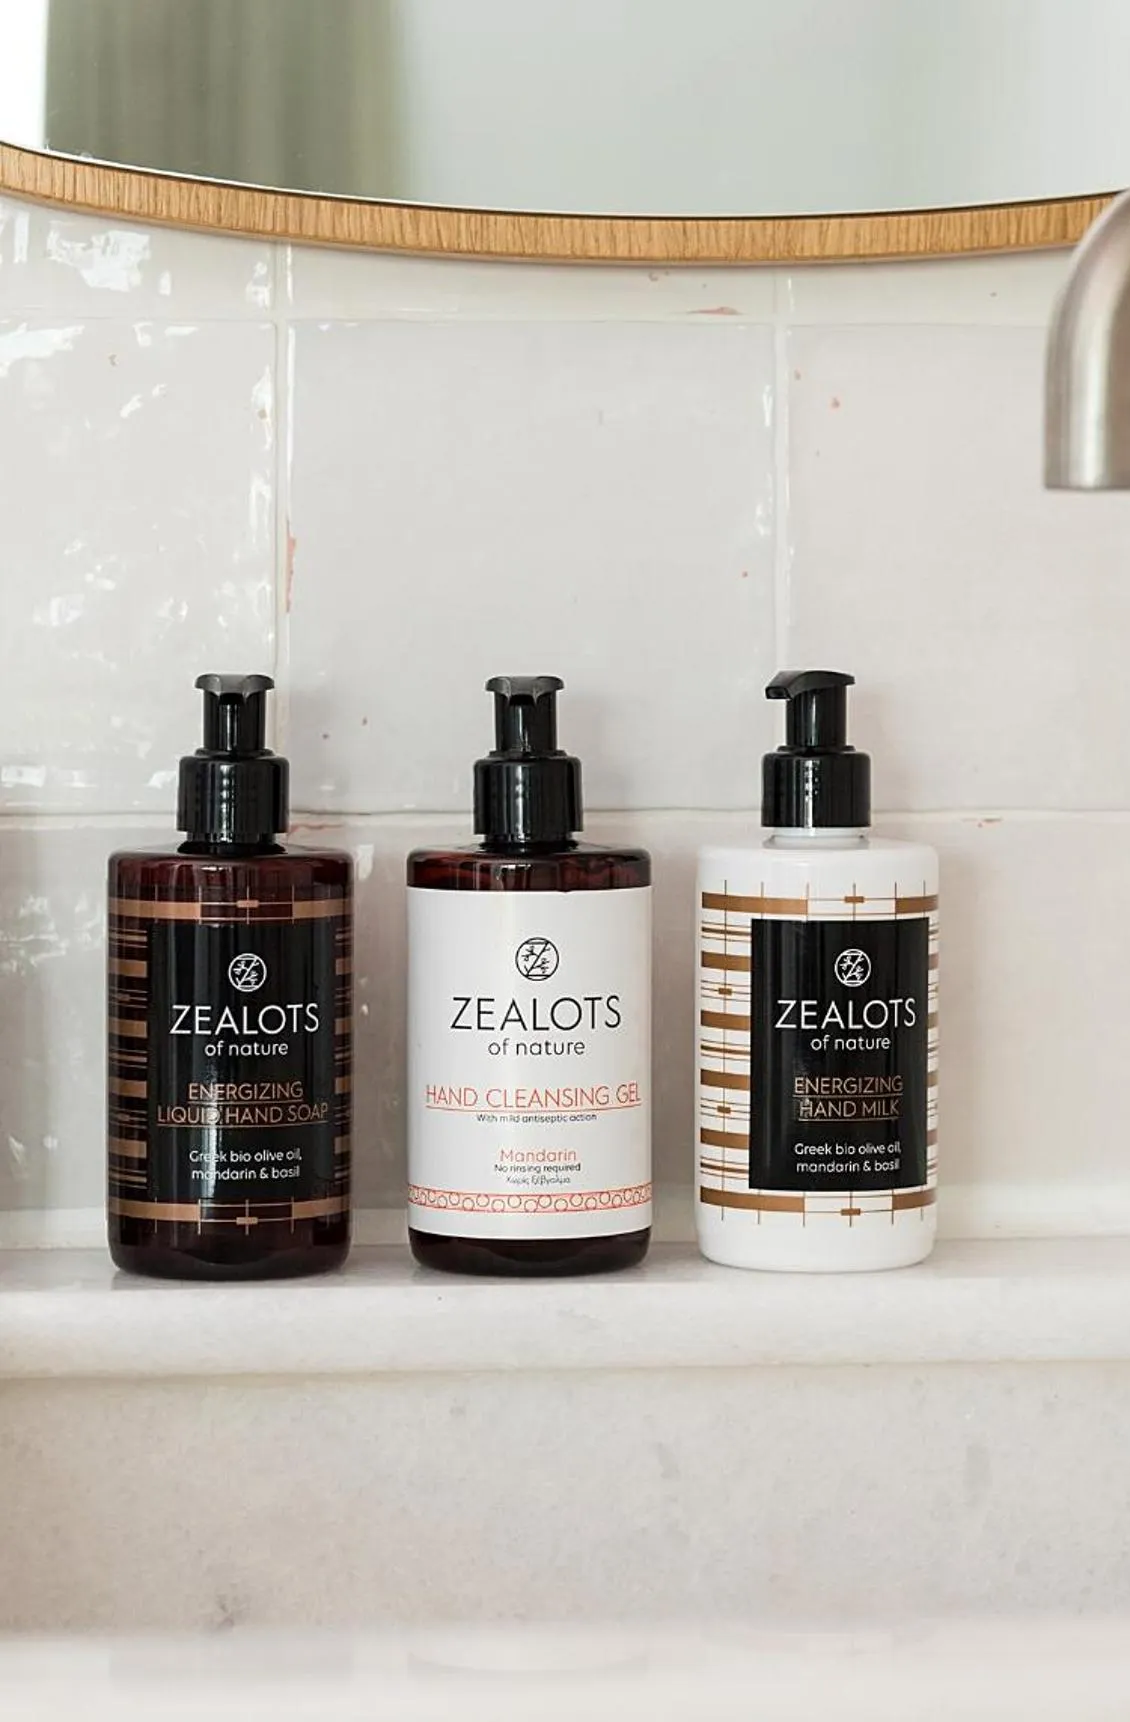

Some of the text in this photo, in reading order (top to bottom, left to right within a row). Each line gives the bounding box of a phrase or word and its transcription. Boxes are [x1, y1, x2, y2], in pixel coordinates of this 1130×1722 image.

[169, 1003, 319, 1035] ZEALOTS
[450, 995, 622, 1031] ZEALOTS
[774, 998, 916, 1030] ZEALOTS
[204, 1040, 289, 1056] of nature
[487, 1038, 586, 1056] of nature
[810, 1034, 891, 1050] of nature
[188, 1081, 304, 1101] ENERGIZING
[794, 1075, 904, 1095] ENERGIZING
[425, 1080, 641, 1109] HAND CLEANSING GEL
[157, 1103, 329, 1124] LIQUID HAND SOAP
[799, 1099, 900, 1118] HAND MILK
[476, 1113, 597, 1124] With mild antiseptic action
[189, 1150, 227, 1162] Greek
[230, 1150, 251, 1162] bio
[254, 1149, 283, 1161] olive
[500, 1148, 577, 1162] Mandarin
[794, 1143, 832, 1155] Greek
[835, 1142, 856, 1155] bio
[858, 1142, 886, 1154] olive
[191, 1165, 300, 1180] mandarin & basil
[494, 1162, 581, 1174] No rinsing required
[796, 1158, 900, 1173] mandarin & basil
